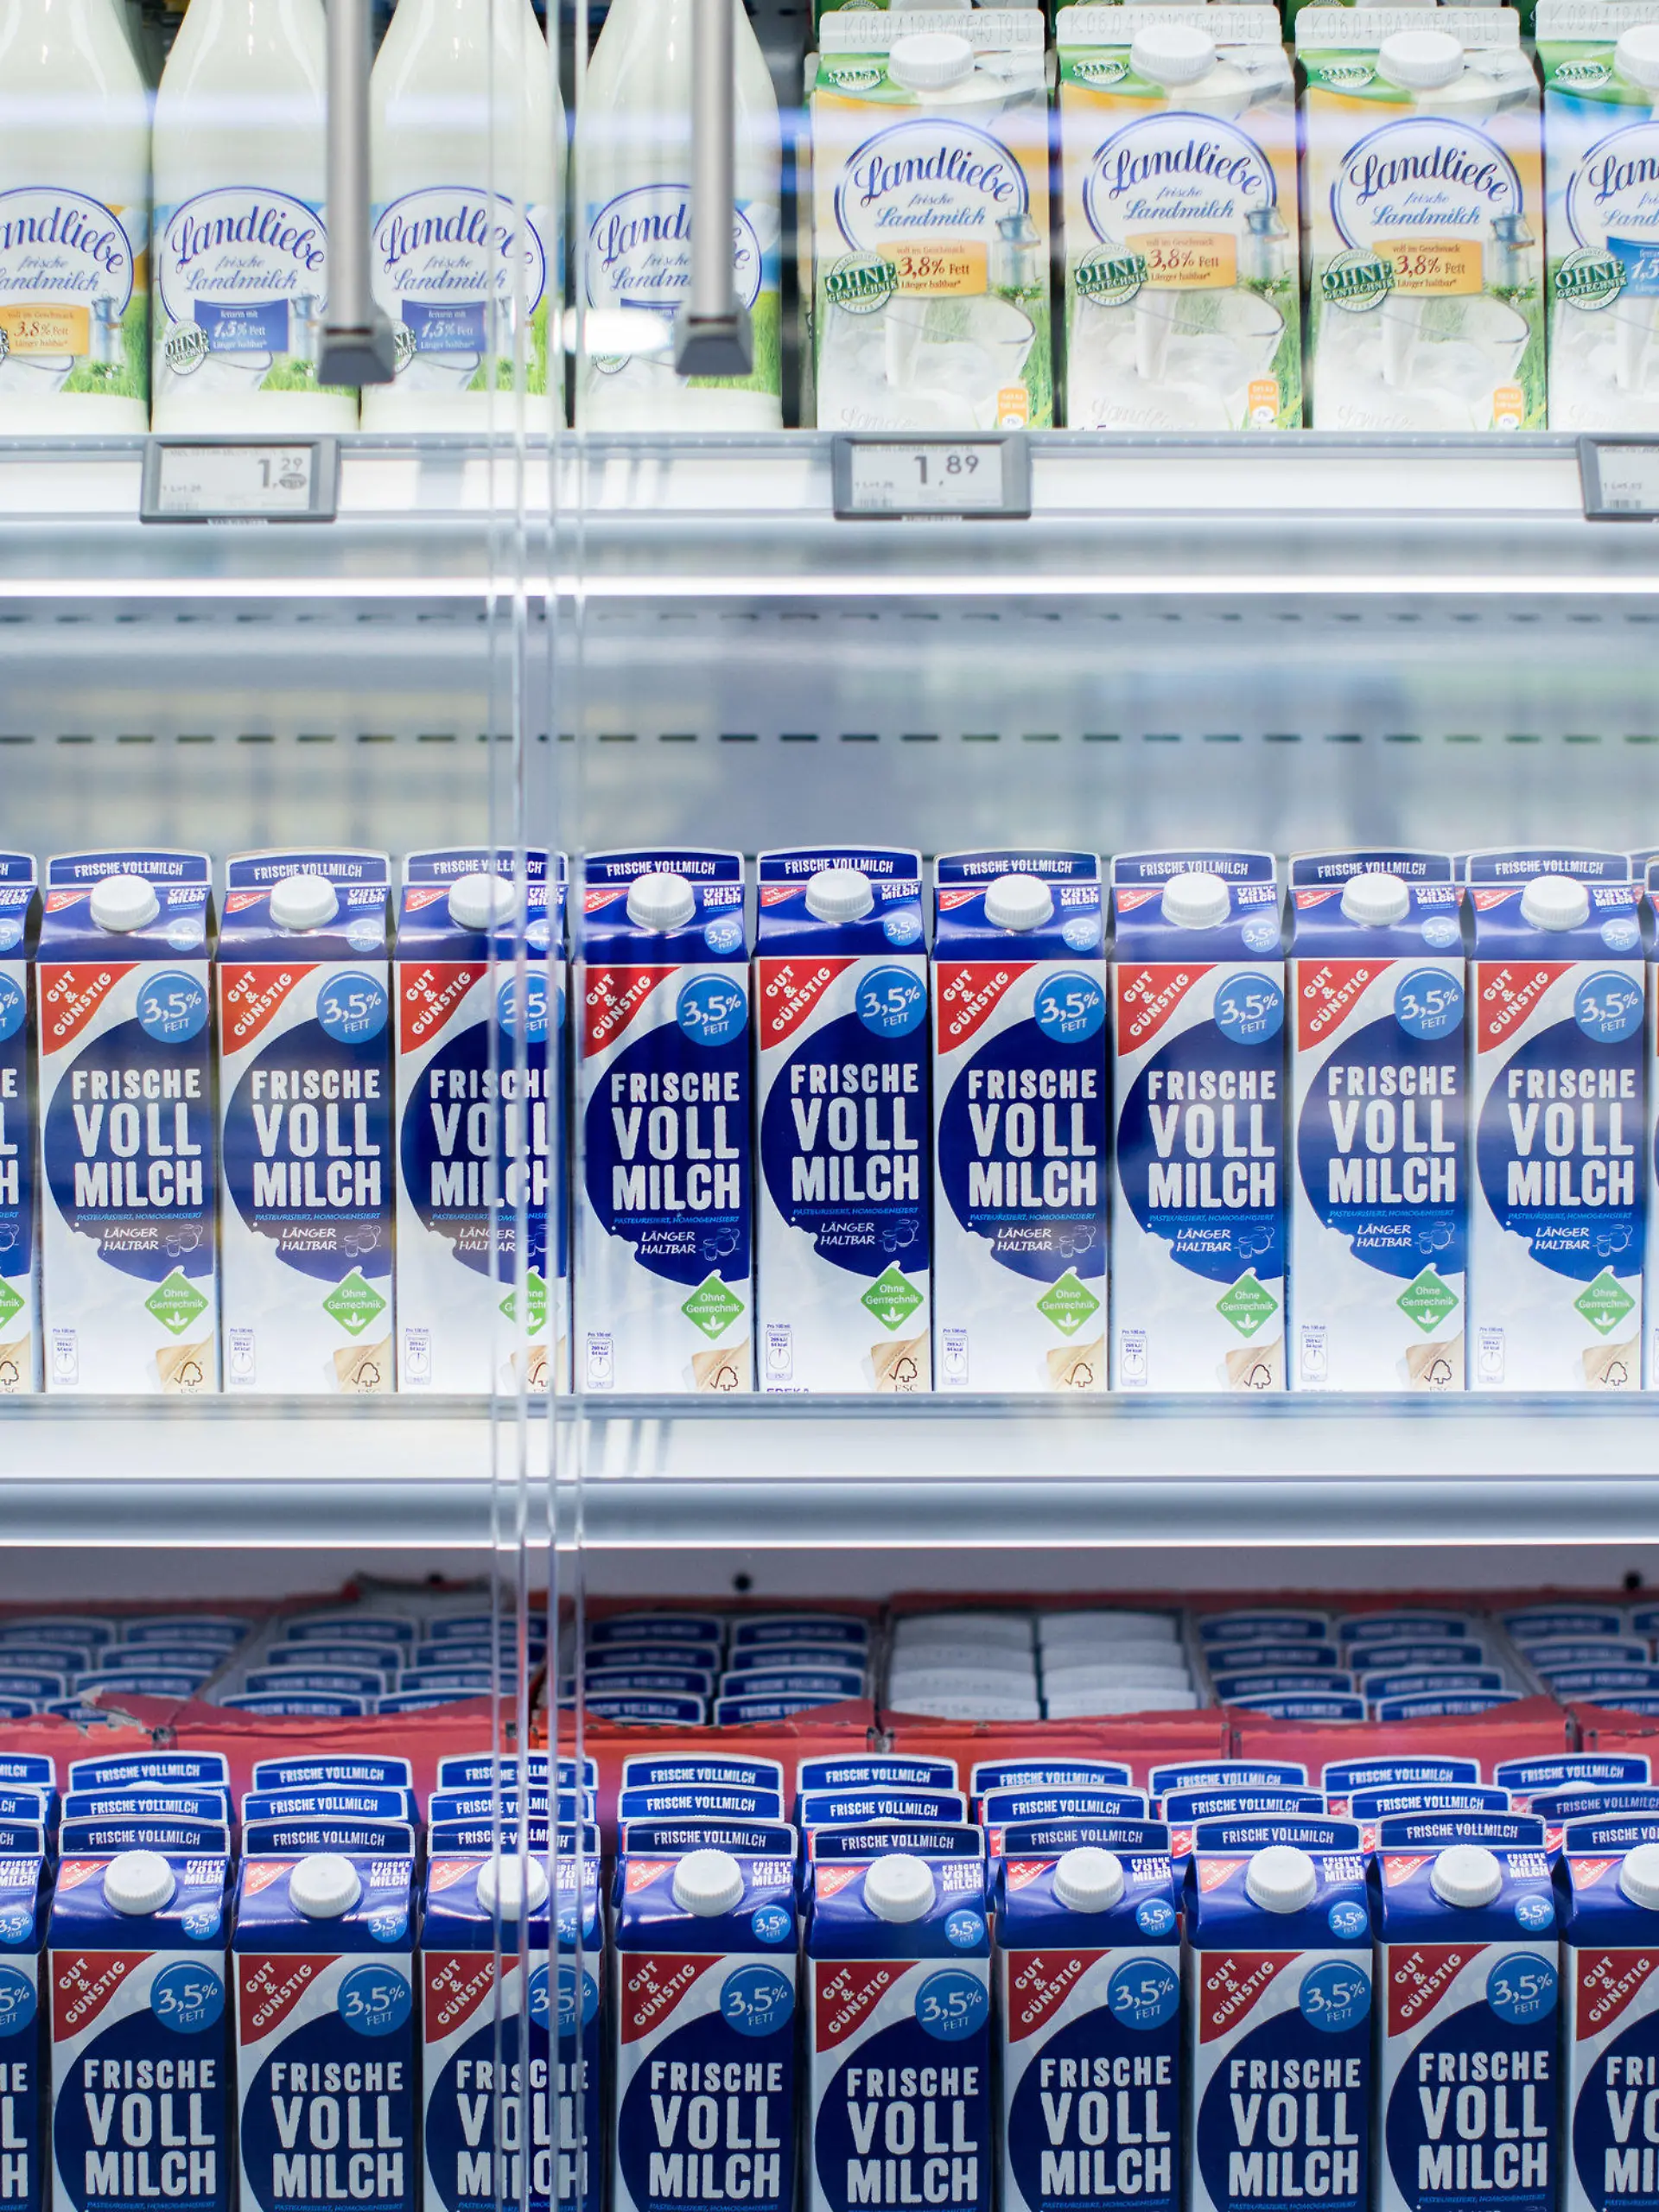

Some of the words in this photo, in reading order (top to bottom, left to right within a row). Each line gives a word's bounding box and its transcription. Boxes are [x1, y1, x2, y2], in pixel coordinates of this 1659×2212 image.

[854, 146, 1014, 207] Landliebe
[1103, 139, 1262, 200] Landliebe
[1350, 145, 1508, 206] Landliebe
[907, 193, 953, 207] frische
[1156, 187, 1203, 200] frische
[1403, 192, 1450, 207] frische
[874, 207, 986, 228] Landmilch
[1123, 200, 1235, 219] Landmilch
[1370, 205, 1481, 226] Landmilch
[172, 206, 324, 273] Landliebe
[897, 257, 944, 278] 3,8%
[949, 265, 969, 275] Fett
[1075, 256, 1144, 285] OHNE
[1147, 249, 1194, 270] 3,8%
[1199, 256, 1218, 267] Fett
[1322, 261, 1392, 289] OHNE
[1395, 254, 1440, 277] 3,8%
[1445, 262, 1465, 274] Fett
[1555, 260, 1624, 289] OHNE
[184, 270, 297, 292] Landmilch
[826, 263, 895, 293] OHNE
[828, 280, 897, 302] GENTECHNIK
[1077, 272, 1147, 295] GENTECHNIK
[1324, 277, 1395, 300] GENTECHNIK
[1557, 276, 1628, 298] GENTECHNIK
[607, 861, 652, 876] FRISCHE
[654, 860, 715, 874] VOLLMILCH
[963, 861, 1008, 875] FRISCHE
[1011, 859, 1072, 874] VOLLMILCH
[227, 969, 256, 1001] GUT
[766, 964, 794, 996] GUT
[784, 985, 797, 999] &
[944, 969, 972, 1001] GUT
[1304, 965, 1332, 997] GUT
[1322, 986, 1335, 1000] &
[143, 991, 201, 1022] 3,5%
[234, 972, 292, 1036] GÜNSTIG
[245, 990, 258, 1004] &
[683, 995, 741, 1026] 3,5%
[772, 967, 830, 1031] GÜNSTIG
[862, 986, 920, 1017] 3,5%
[950, 971, 1008, 1035] GÜNSTIG
[962, 989, 975, 1003] &
[1220, 993, 1278, 1024] 3,5%
[1311, 968, 1369, 1032] GÜNSTIG
[164, 1018, 189, 1033] FETT
[703, 1021, 728, 1036] FETT
[883, 1013, 908, 1027] FETT
[1241, 1020, 1266, 1034] FETT
[73, 1070, 200, 1100] FRISCHE
[251, 1070, 379, 1100] FRISCHE
[611, 1072, 739, 1103] FRISCHE
[791, 1064, 918, 1094] FRISCHE
[969, 1070, 1096, 1100] FRISCHE
[1148, 1071, 1276, 1101] FRISCHE
[1328, 1066, 1456, 1096] FRISCHE
[1508, 1069, 1636, 1099] FRISCHE
[73, 1103, 200, 1156] VOLL
[251, 1103, 379, 1157] VOLL
[611, 1106, 739, 1160] VOLL
[791, 1097, 918, 1151] VOLL
[969, 1103, 1096, 1157] VOLL
[1147, 1104, 1275, 1158] VOLL
[1328, 1099, 1456, 1153] VOLL
[1507, 1103, 1635, 1156] VOLL
[74, 1160, 201, 1206] MILCH
[253, 1161, 380, 1207] MILCH
[612, 1164, 739, 1210] MILCH
[791, 1155, 918, 1201] MILCH
[969, 1161, 1096, 1207] MILCH
[1148, 1162, 1275, 1208] MILCH
[1328, 1157, 1455, 1203] MILCH
[1507, 1160, 1634, 1206] MILCH
[641, 1230, 695, 1242] LÄNGER
[821, 1221, 874, 1233] LÄNGER
[821, 1235, 875, 1245] HALTBAR
[1177, 1228, 1230, 1240] LÄNGER
[641, 1243, 696, 1254] HALTBAR
[1177, 1242, 1231, 1252] HALTBAR
[687, 1305, 740, 1313] Gentechnik
[866, 1296, 918, 1305] Gentechnik
[651, 1768, 694, 1783] FRISCHE
[697, 1768, 756, 1784] VOLLMILCH
[1521, 1768, 1561, 1783] FRISCHE
[1564, 1766, 1624, 1780] VOLLMILCH
[270, 1798, 315, 1814] FRISCHE
[317, 1797, 378, 1812] VOLLMILCH
[830, 1802, 875, 1817] FRISCHE
[877, 1802, 938, 1816] VOLLMILCH
[88, 1831, 135, 1845] FRISCHE
[137, 1831, 200, 1844] VOLLMILCH
[653, 1831, 700, 1845] FRISCHE
[703, 1833, 766, 1846] VOLLMILCH
[1031, 1831, 1077, 1845] FRISCHE
[1080, 1830, 1143, 1843] VOLLMILCH
[1407, 1825, 1453, 1839] FRISCHE
[1455, 1824, 1518, 1837] VOLLMILCH
[245, 1961, 274, 1993] GUT
[264, 1981, 277, 1994] &
[1014, 1957, 1044, 1988] GUT
[1034, 1977, 1047, 1990] &
[157, 1980, 217, 2014] 3,5%
[252, 1962, 313, 2028] GÜNSTIG
[1021, 1958, 1082, 2024] GÜNSTIG
[1492, 1972, 1552, 2005] 3,5%
[180, 2008, 205, 2024] FETT
[922, 1988, 982, 2022] 3,5%
[1515, 1999, 1540, 2015] FETT
[944, 2016, 969, 2031] FETT
[84, 2058, 214, 2090] FRISCHE
[652, 2061, 782, 2093] FRISCHE
[1040, 2056, 1171, 2088] FRISCHE
[1230, 2057, 1361, 2089] FRISCHE
[1419, 2050, 1549, 2082] FRISCHE
[848, 2066, 978, 2098] FRISCHE
[84, 2091, 214, 2147] VOLL
[650, 2094, 780, 2150] VOLL
[847, 2099, 977, 2155] VOLL
[1040, 2089, 1171, 2145] VOLL
[1230, 2091, 1360, 2147] VOLL
[1418, 2084, 1548, 2140] VOLL
[85, 2149, 215, 2197] MILCH
[649, 2152, 779, 2200] MILCH
[847, 2156, 977, 2204] MILCH
[1040, 2147, 1171, 2196] MILCH
[1228, 2149, 1358, 2197] MILCH
[1417, 2142, 1548, 2190] MILCH
